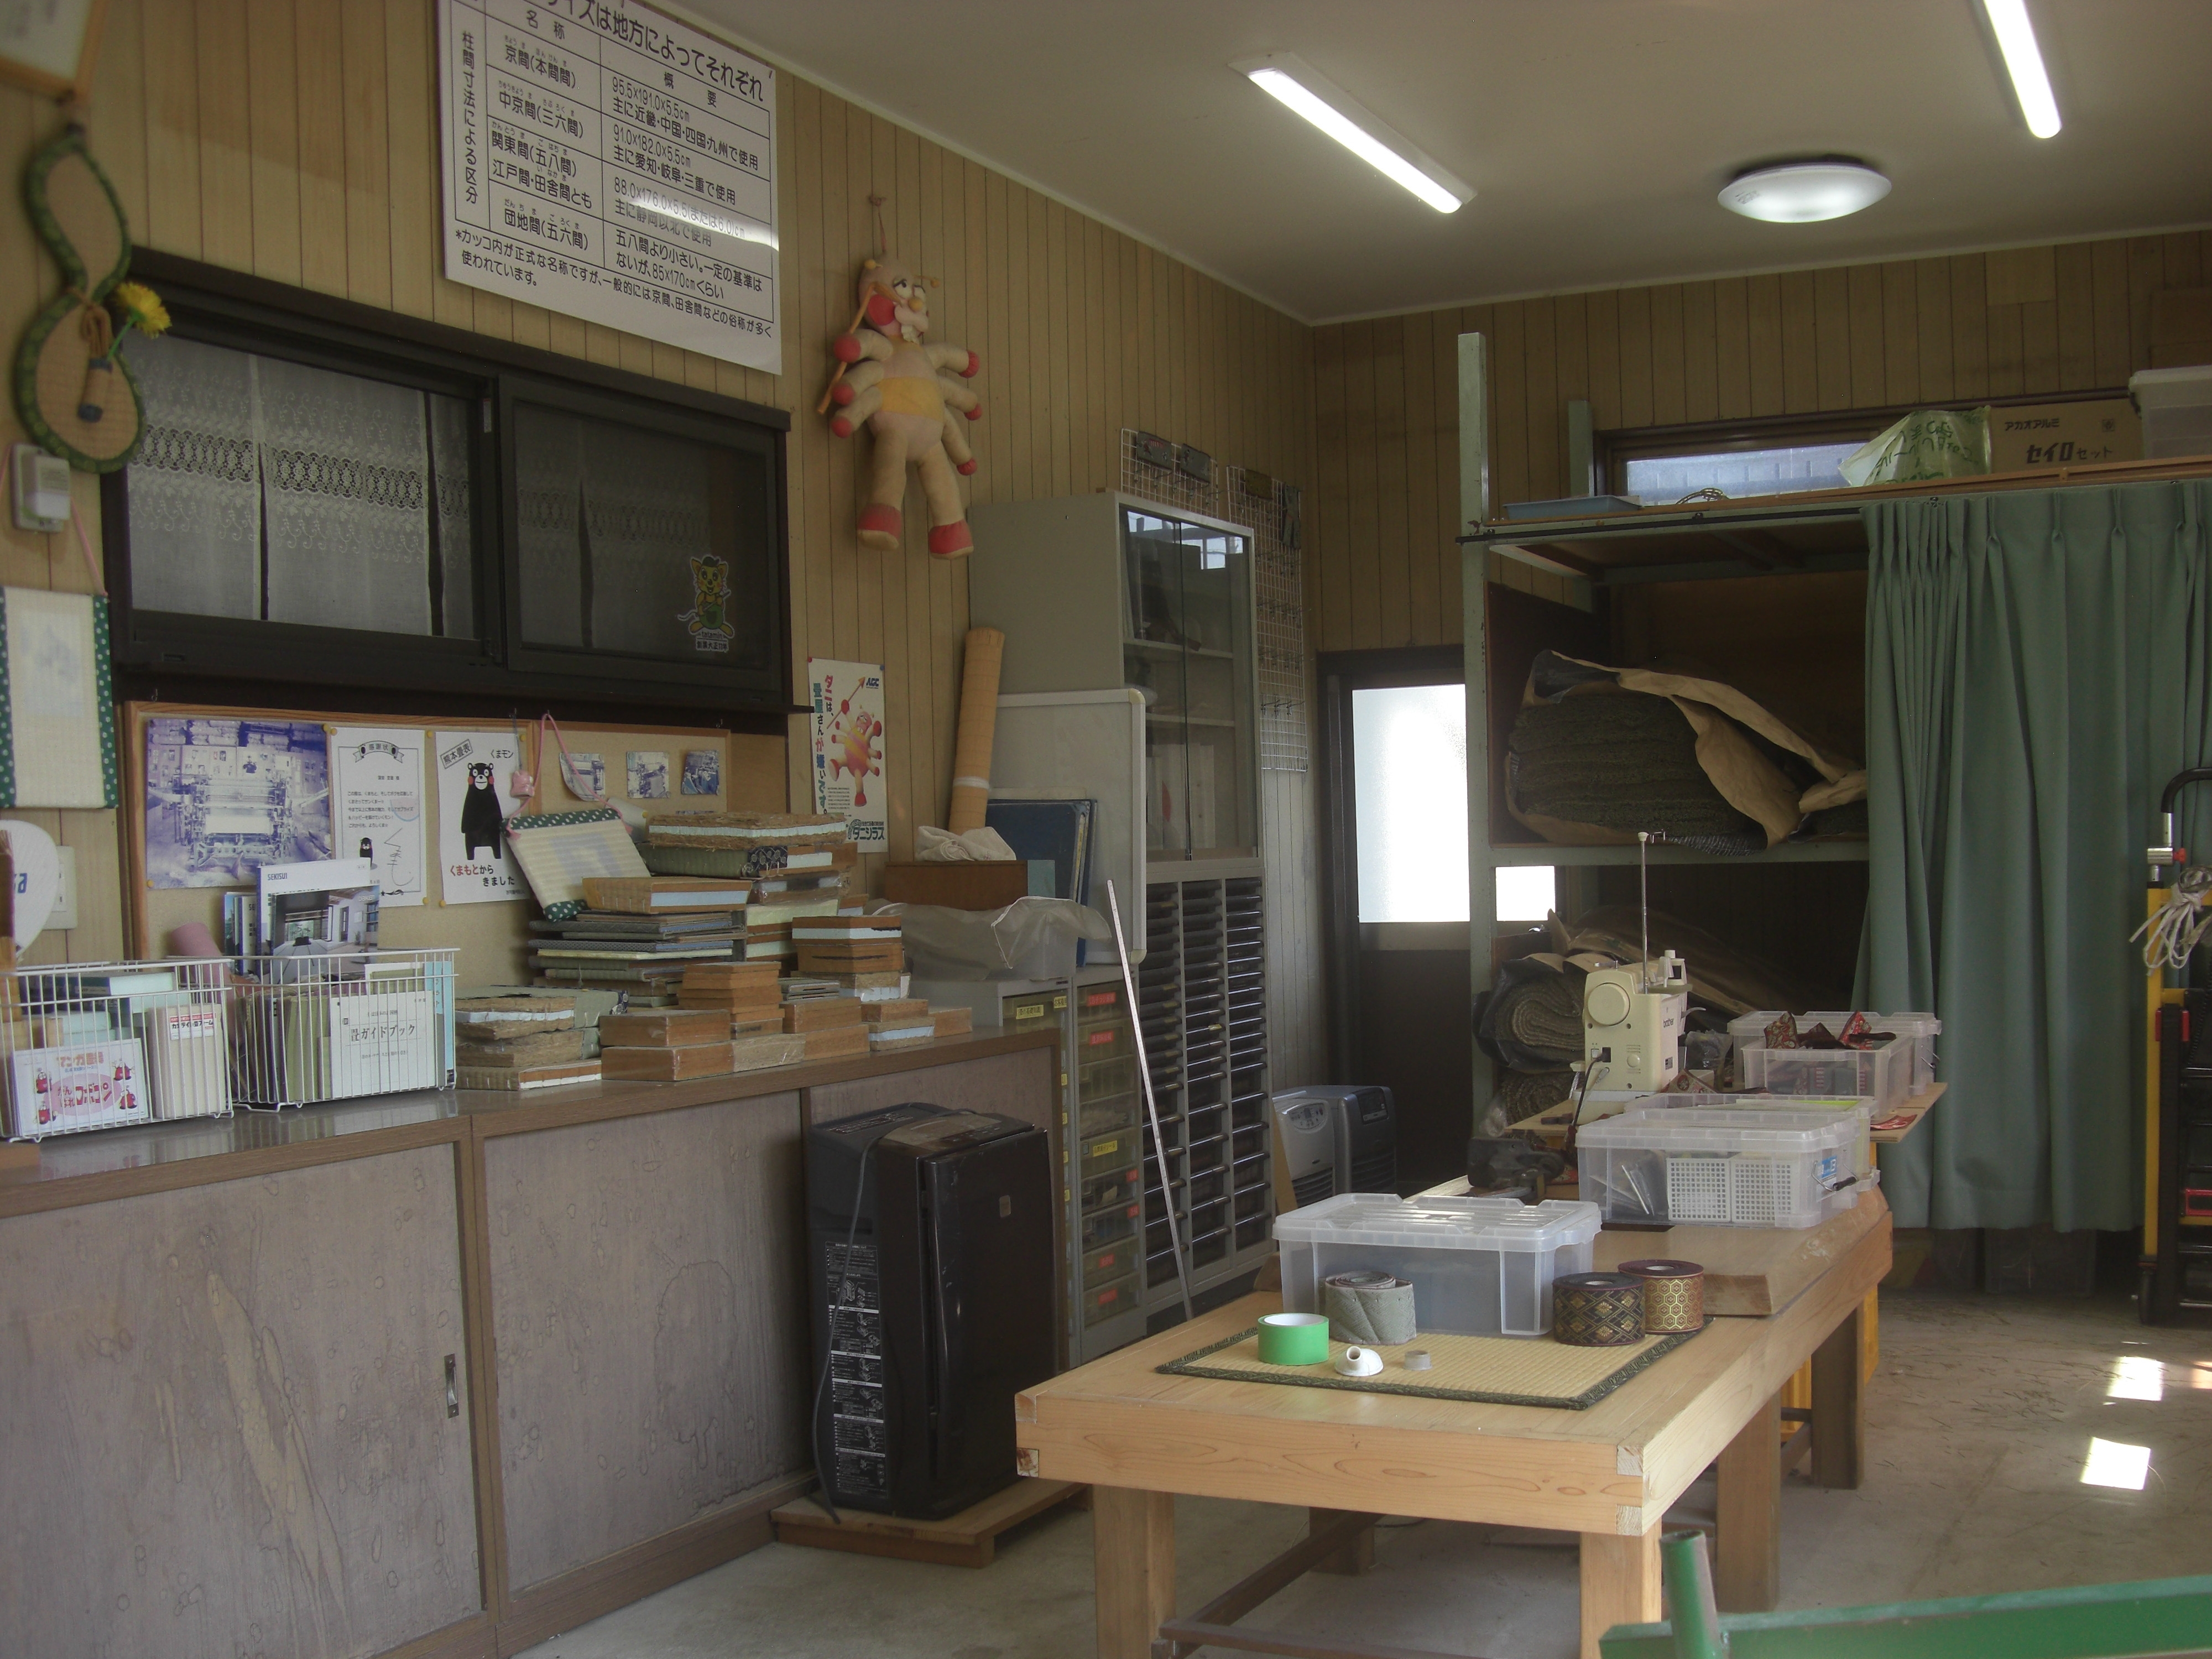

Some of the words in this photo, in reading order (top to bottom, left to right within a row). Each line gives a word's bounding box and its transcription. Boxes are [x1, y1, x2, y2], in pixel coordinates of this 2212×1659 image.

[505, 44, 576, 89] 京間(本間間)
[549, 0, 764, 102] イズは地方によってそれぞれ
[462, 31, 478, 204] 柱間寸法による区分
[499, 91, 583, 138] 中京間(三六間)
[613, 96, 758, 171] 主に近畿・中国・四国・九州で使用
[492, 131, 577, 178] 関東間(五八間)
[614, 144, 736, 206] 主に愛知・岐阜・三重で使用
[493, 158, 592, 209] 江戸間・田舎間とも
[505, 208, 588, 251] 団地間(五六間)
[614, 198, 712, 247] 主に静岡以北で使用
[462, 249, 538, 286] 使われています。
[615, 229, 763, 293] 五八間より小さい。一定の基準は
[2004, 418, 2060, 431] アカオアルミ
[866, 677, 879, 687] AGC
[443, 743, 471, 766] 熊本畳表
[491, 749, 514, 759] くまモン
[813, 682, 827, 815] 畳屋さんが嫌いです。
[267, 872, 288, 881] SEKISUI
[450, 864, 494, 877] くまもとから
[483, 876, 515, 887] きました
[351, 1024, 415, 1042] 畳ガイドブック
